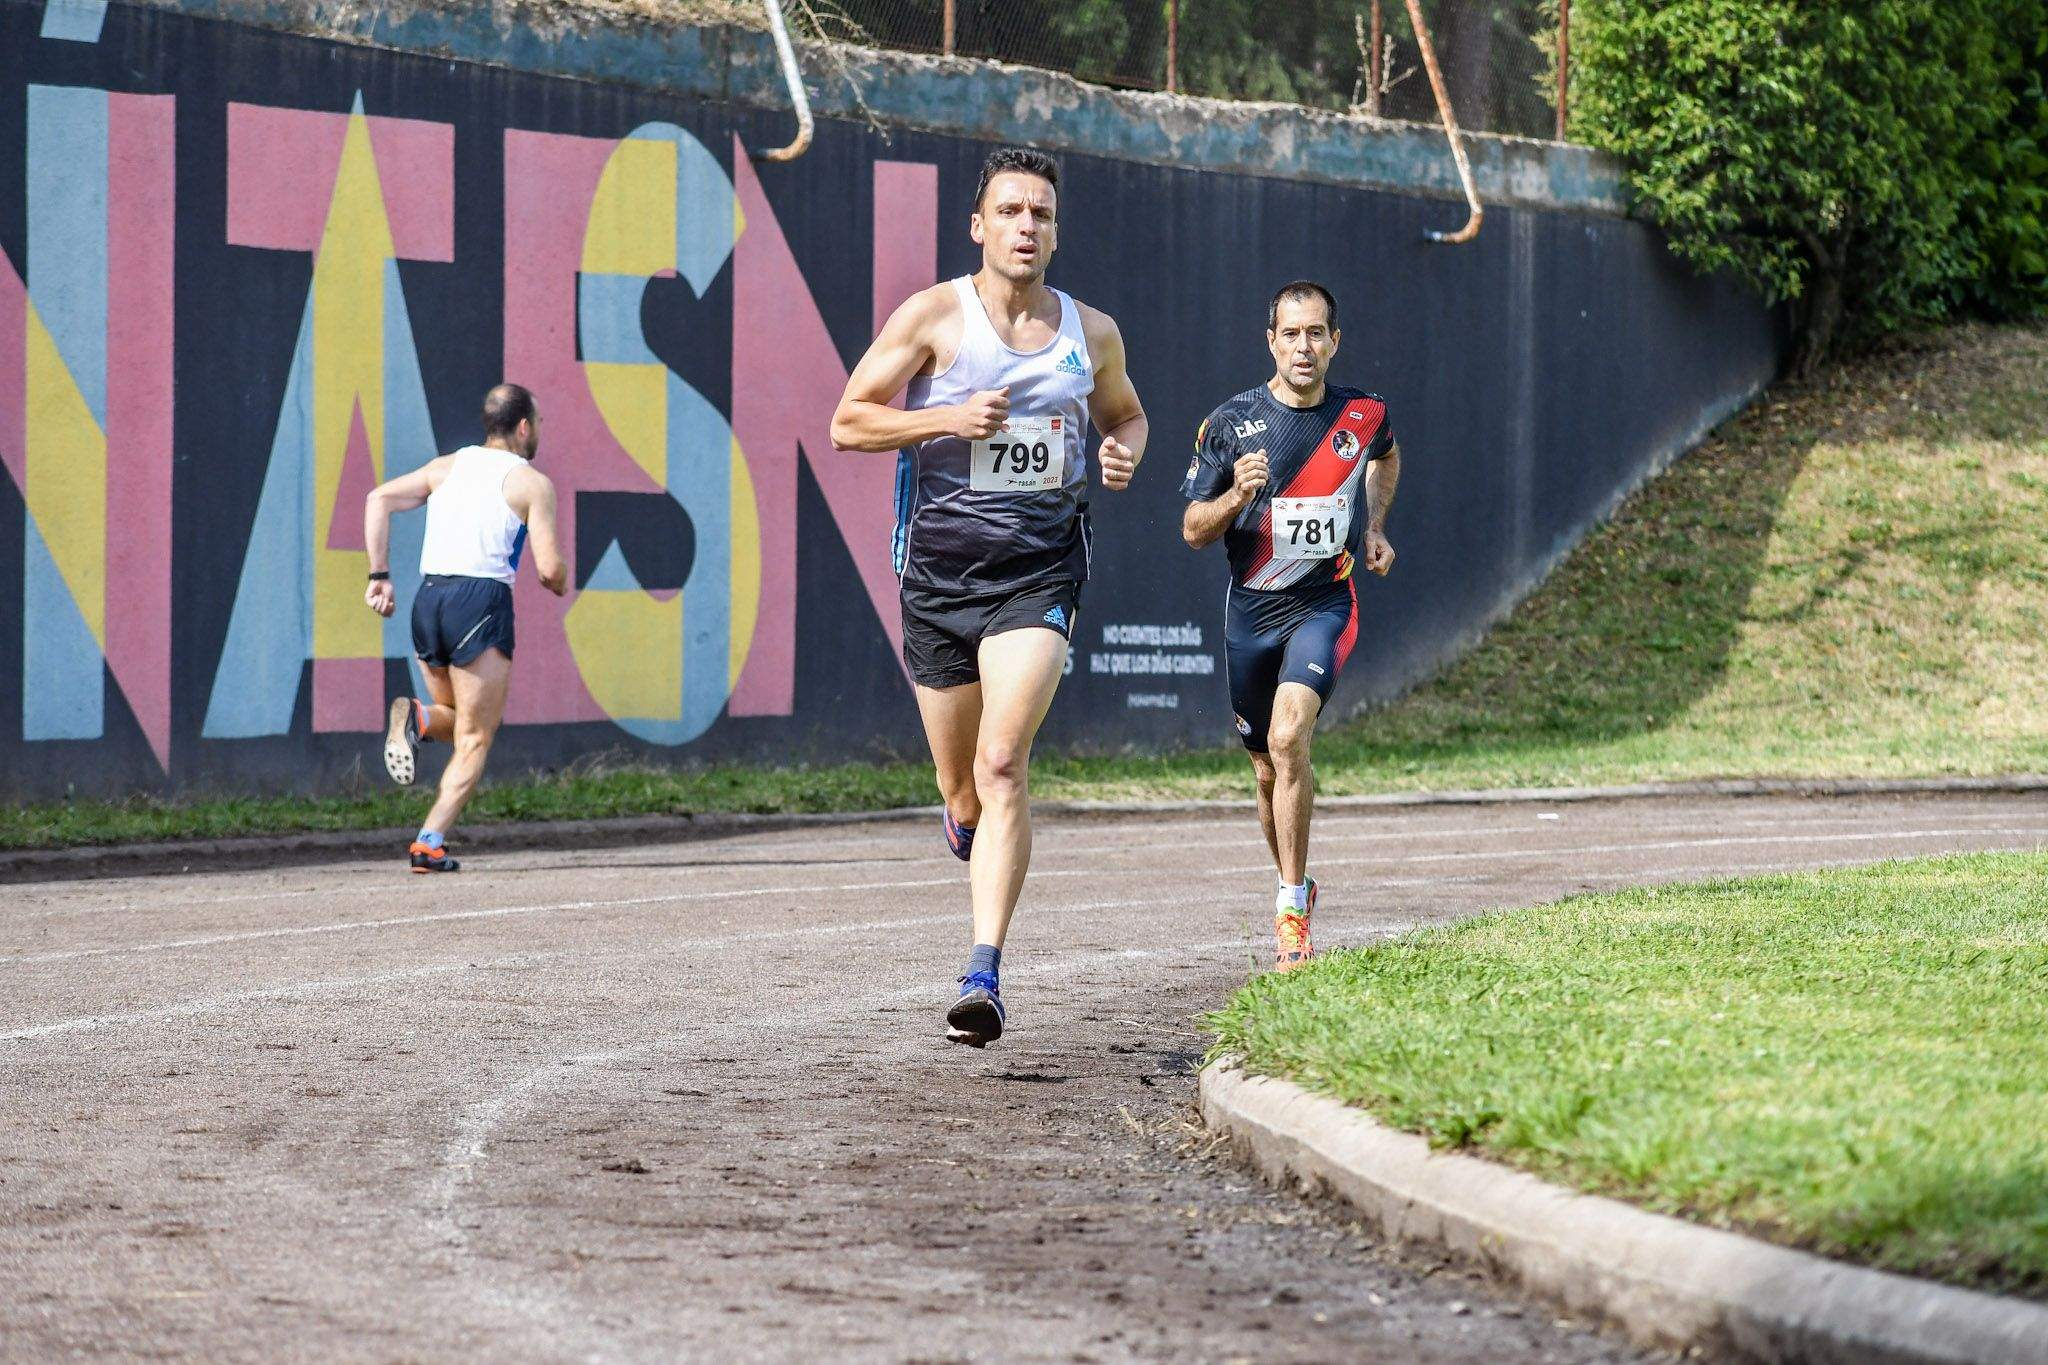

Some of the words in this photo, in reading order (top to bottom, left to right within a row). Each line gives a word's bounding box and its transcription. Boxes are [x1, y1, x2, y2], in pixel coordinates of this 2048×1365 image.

[1056, 364, 1087, 377] adidas
[1234, 419, 1268, 439] CAG
[989, 442, 1049, 473] 799
[1042, 476, 1058, 485] 2023
[1287, 517, 1335, 545] 781
[1103, 624, 1119, 645] NO
[1110, 653, 1131, 676] QUE
